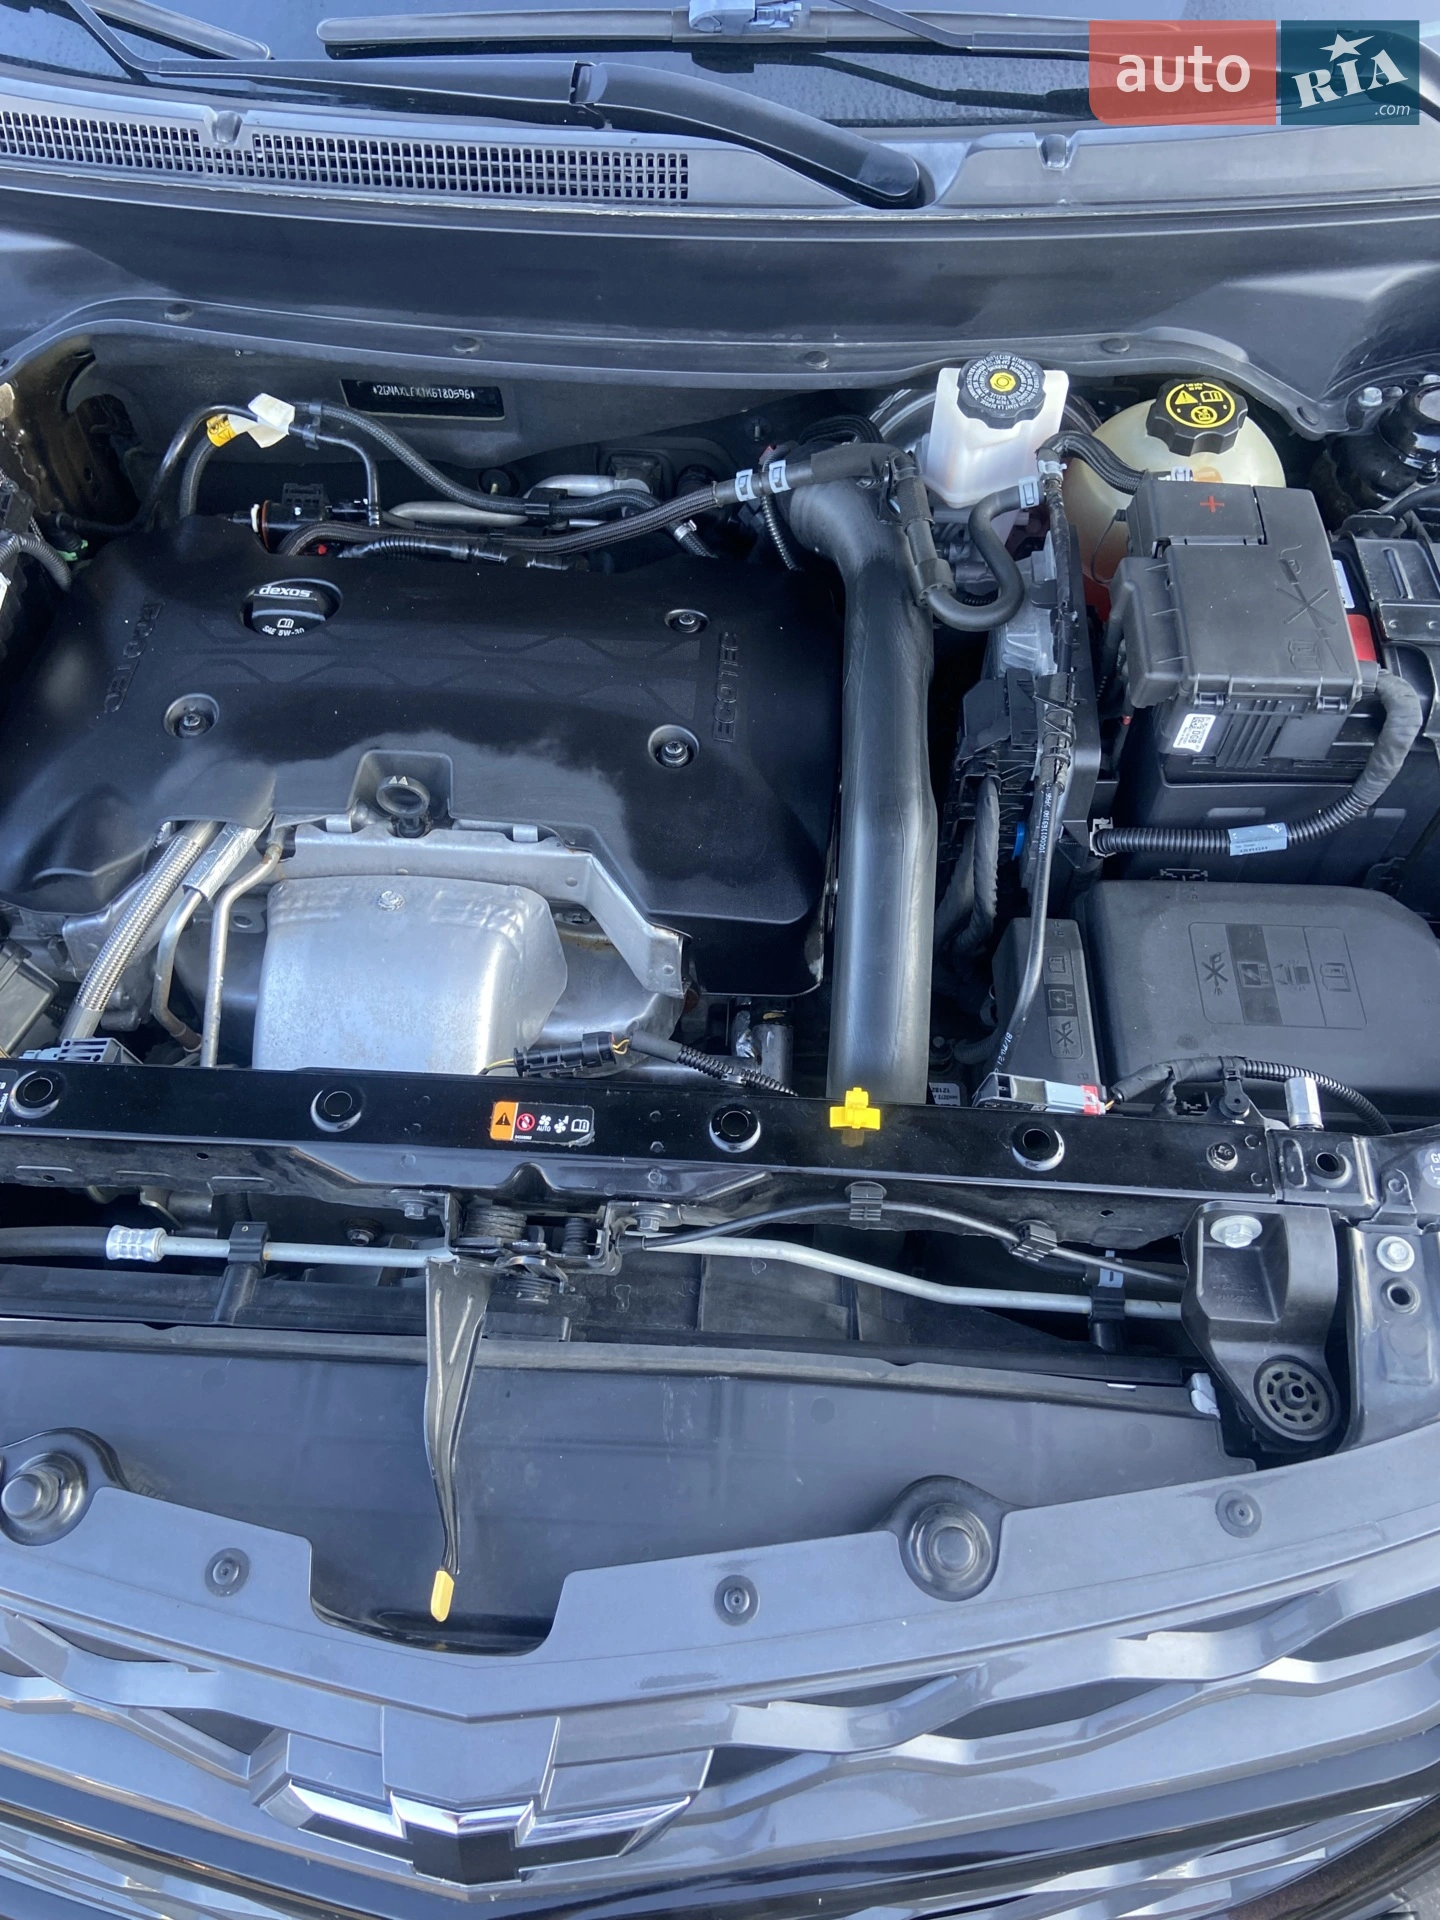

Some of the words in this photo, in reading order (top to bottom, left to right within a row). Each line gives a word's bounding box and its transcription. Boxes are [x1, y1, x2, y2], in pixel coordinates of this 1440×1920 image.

[258, 585, 313, 598] dexos
[262, 625, 276, 636] SAE
[712, 631, 740, 743] ECOTEC
